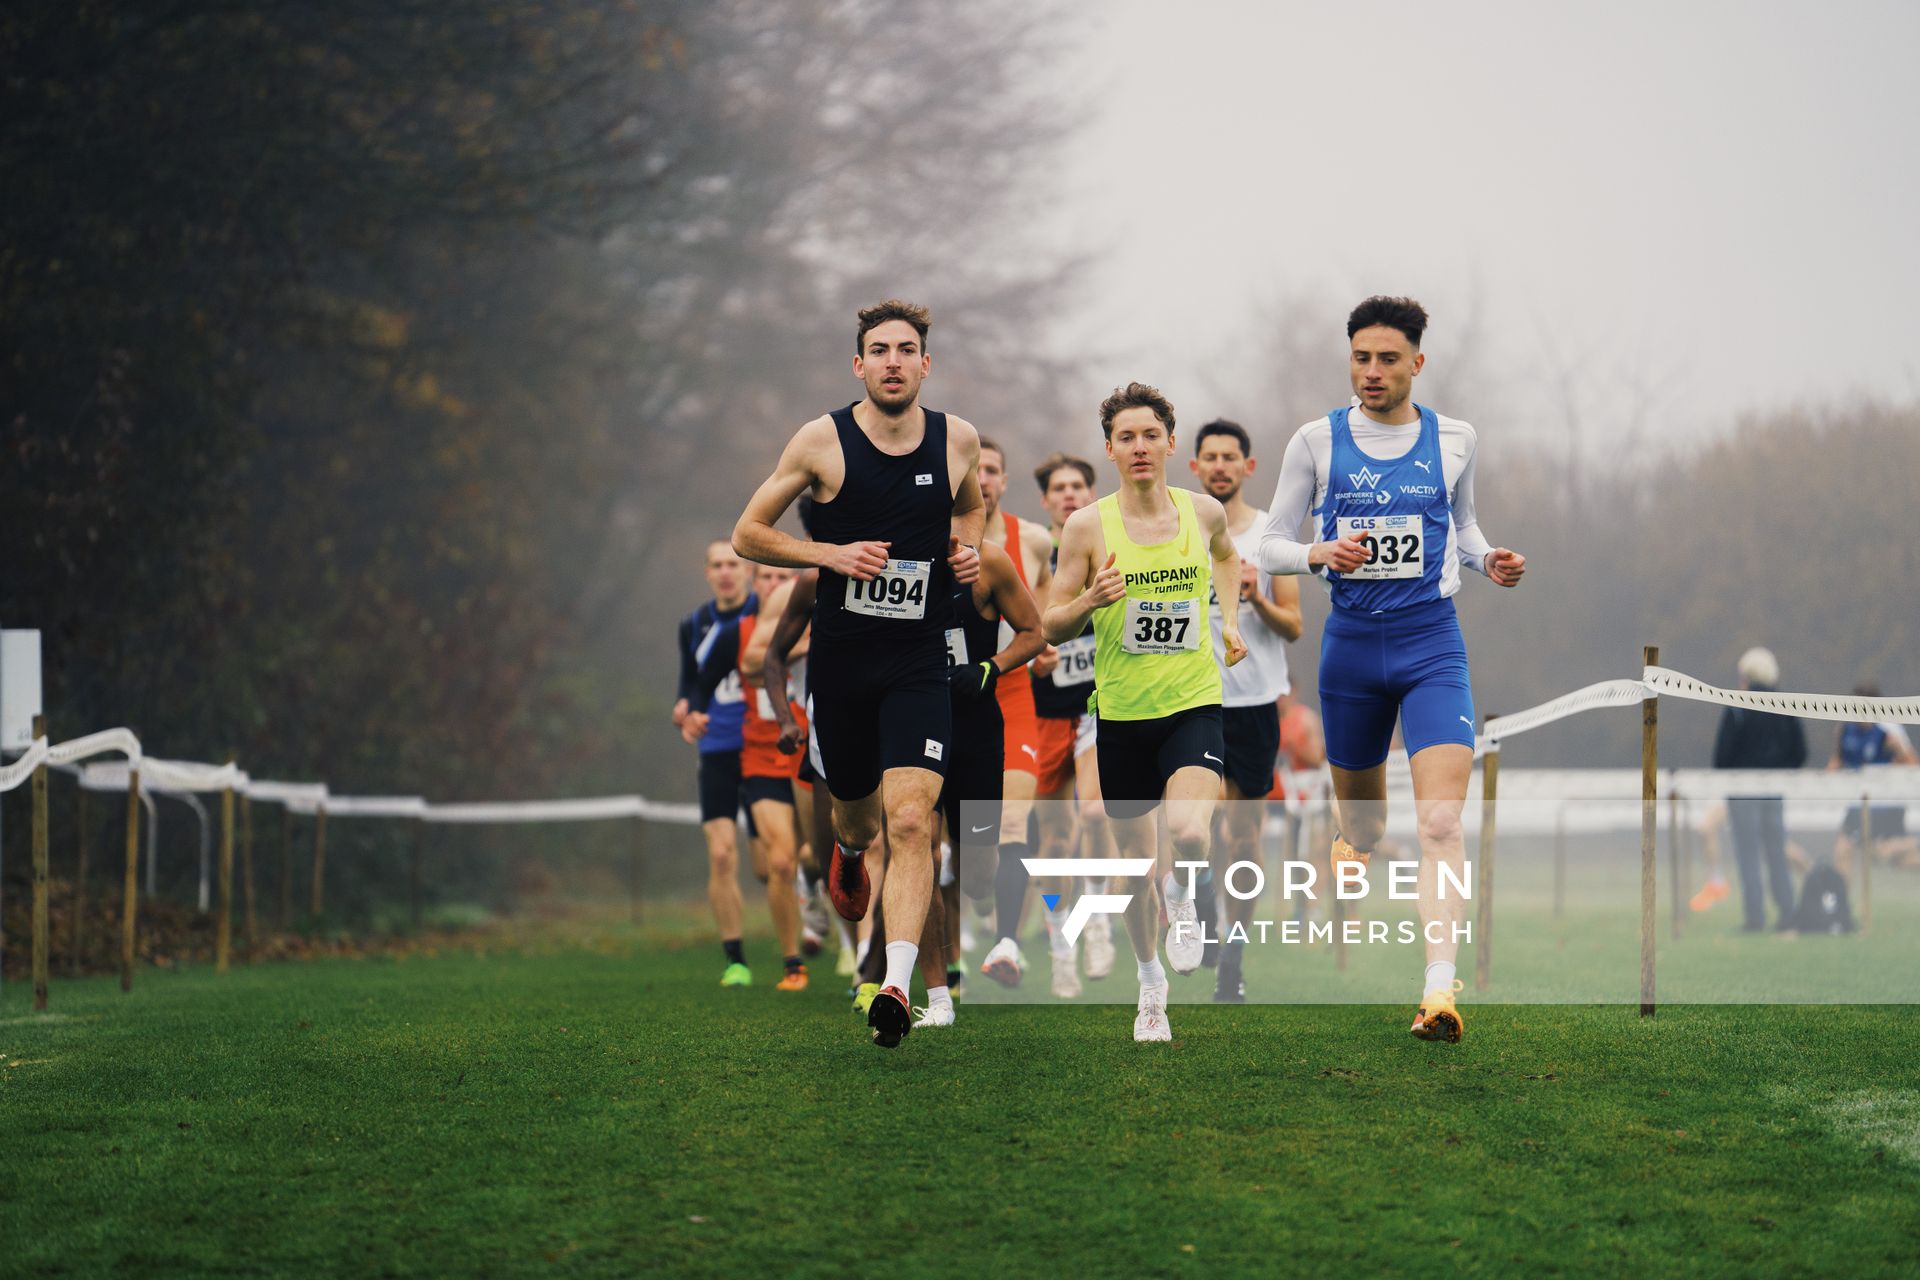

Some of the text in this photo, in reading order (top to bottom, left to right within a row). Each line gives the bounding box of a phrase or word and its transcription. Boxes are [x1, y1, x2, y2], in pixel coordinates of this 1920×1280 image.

[1400, 485, 1438, 495] VIACTIV
[1360, 534, 1420, 565] 032
[1125, 566, 1198, 586] PINGPANK
[1155, 581, 1194, 594] running
[851, 576, 924, 606] 1094
[1134, 616, 1190, 643] 387
